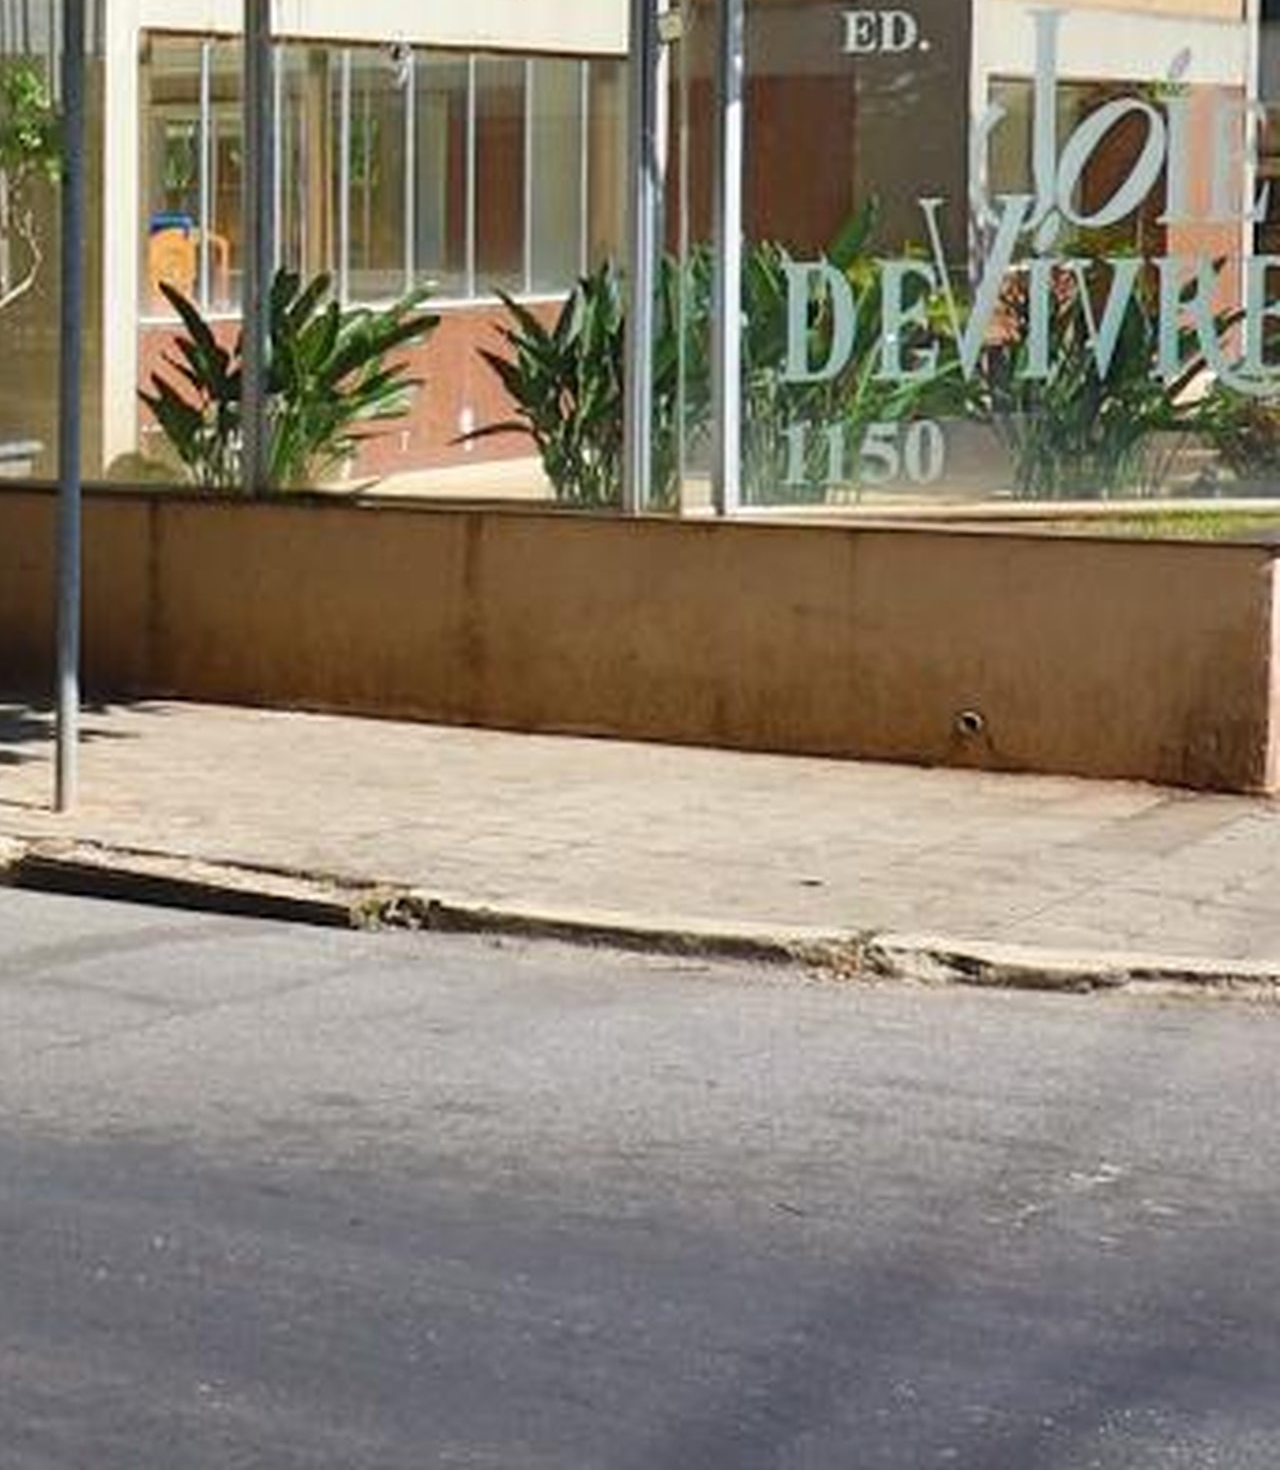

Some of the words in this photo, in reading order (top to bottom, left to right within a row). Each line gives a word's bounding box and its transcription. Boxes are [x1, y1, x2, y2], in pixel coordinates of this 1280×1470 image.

[842, 10, 930, 53] ED.
[779, 258, 940, 382] DE
[781, 420, 944, 486] 1150
